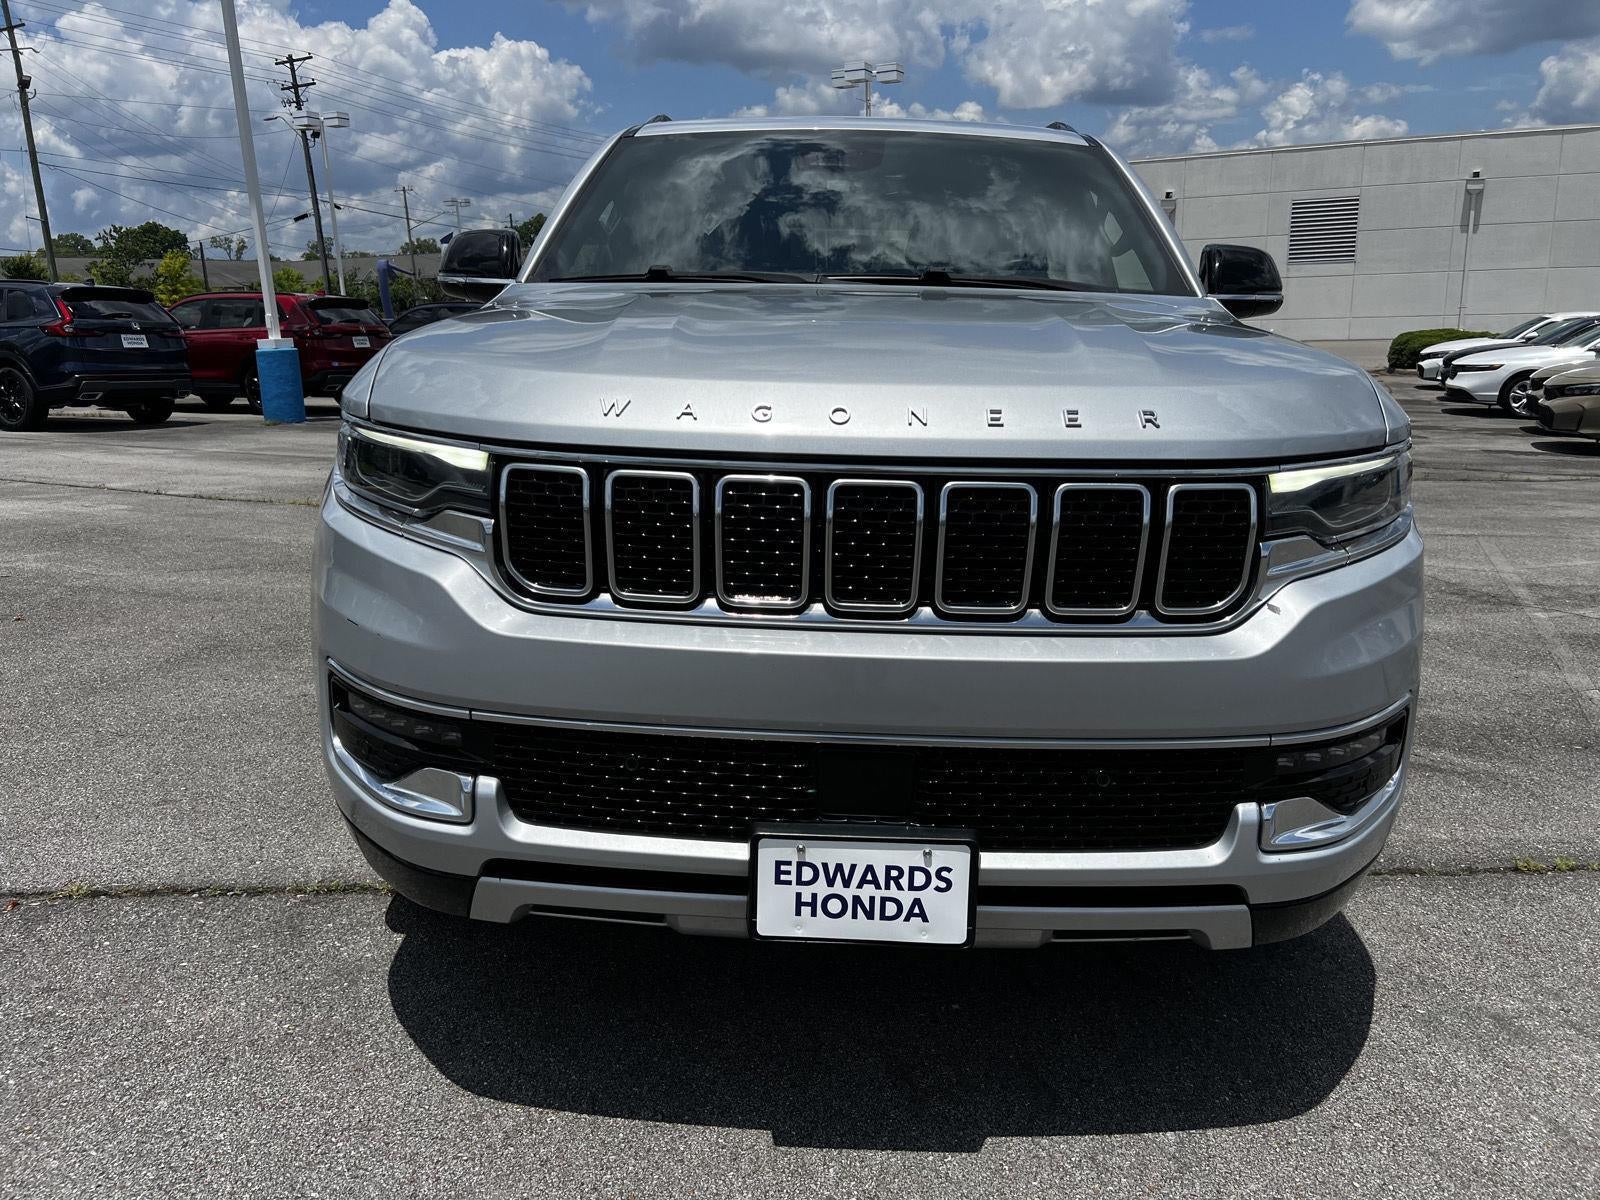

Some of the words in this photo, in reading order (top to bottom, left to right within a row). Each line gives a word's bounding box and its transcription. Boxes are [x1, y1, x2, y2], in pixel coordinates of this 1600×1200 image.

[599, 396, 1161, 430] WAGONEER
[774, 859, 954, 893] EDWARDS
[794, 891, 930, 923] HONDA
